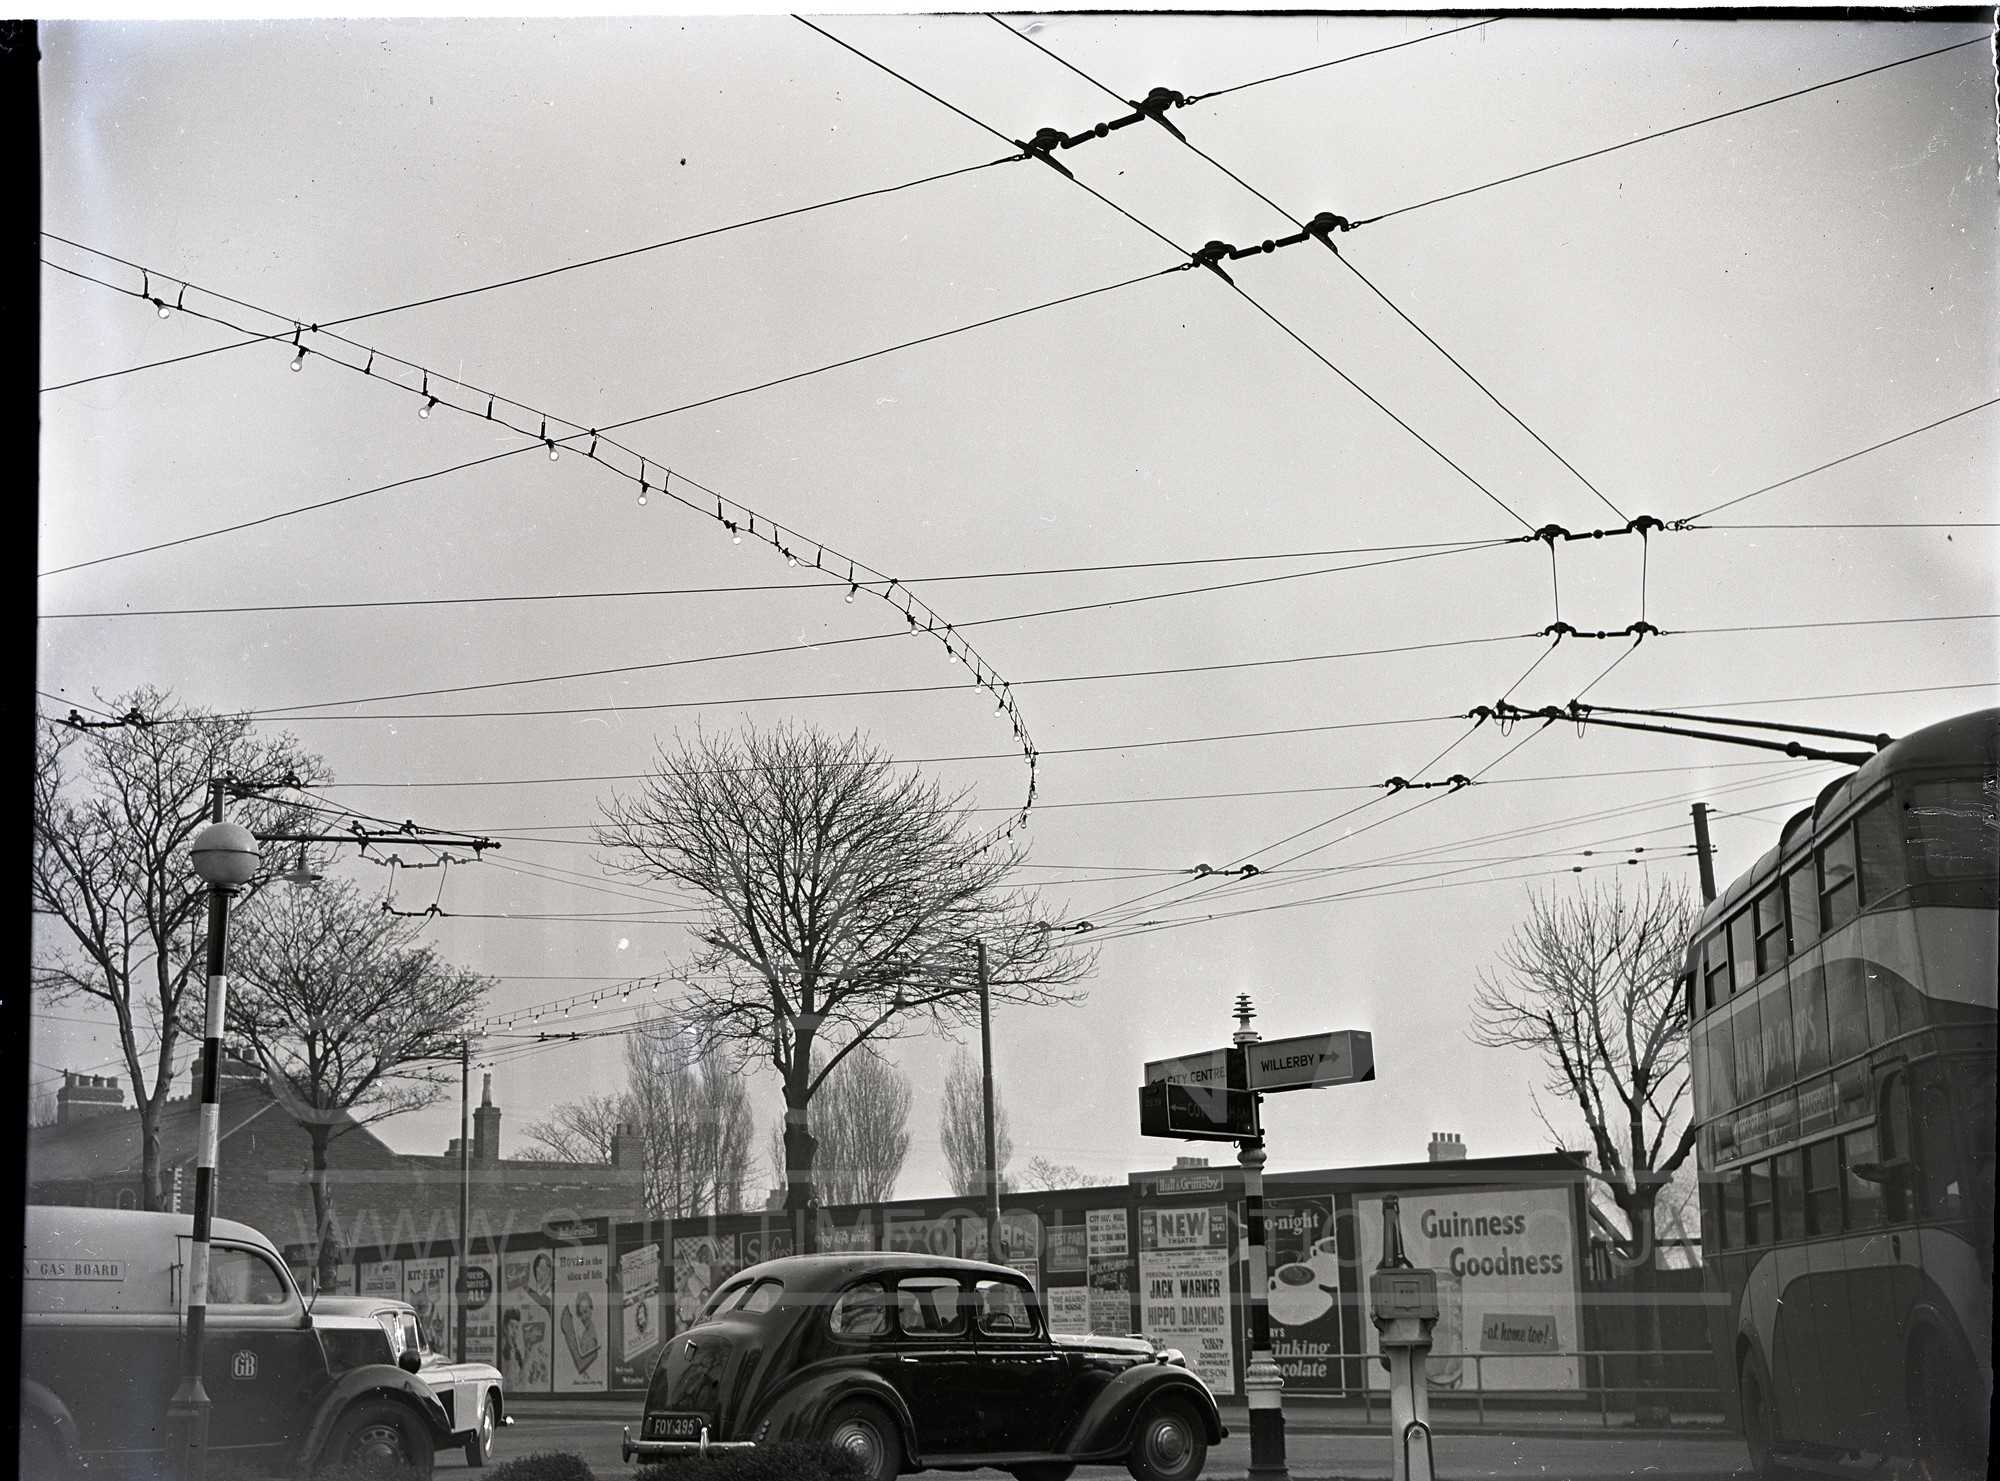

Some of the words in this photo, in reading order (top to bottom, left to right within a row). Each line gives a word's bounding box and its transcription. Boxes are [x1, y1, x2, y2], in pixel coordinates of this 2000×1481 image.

[1260, 1053, 1314, 1072] WILLERBY
[1167, 1073, 1187, 1084] CITY
[1190, 1066, 1225, 1082] CENTRE
[1161, 1211, 1206, 1238] NEW
[1263, 1211, 1319, 1235] o-night
[1421, 1209, 1526, 1239] Guinness
[40, 1263, 64, 1276] GAS
[74, 1263, 119, 1276] BOARD
[1450, 1246, 1562, 1277] Goodness
[1150, 1279, 1174, 1299] JACK
[1180, 1278, 1221, 1298] WARNER
[1148, 1306, 1176, 1326] HIPPO
[1182, 1305, 1225, 1326] DANCING
[1271, 1339, 1330, 1361] rinking
[654, 1418, 673, 1435] FOY
